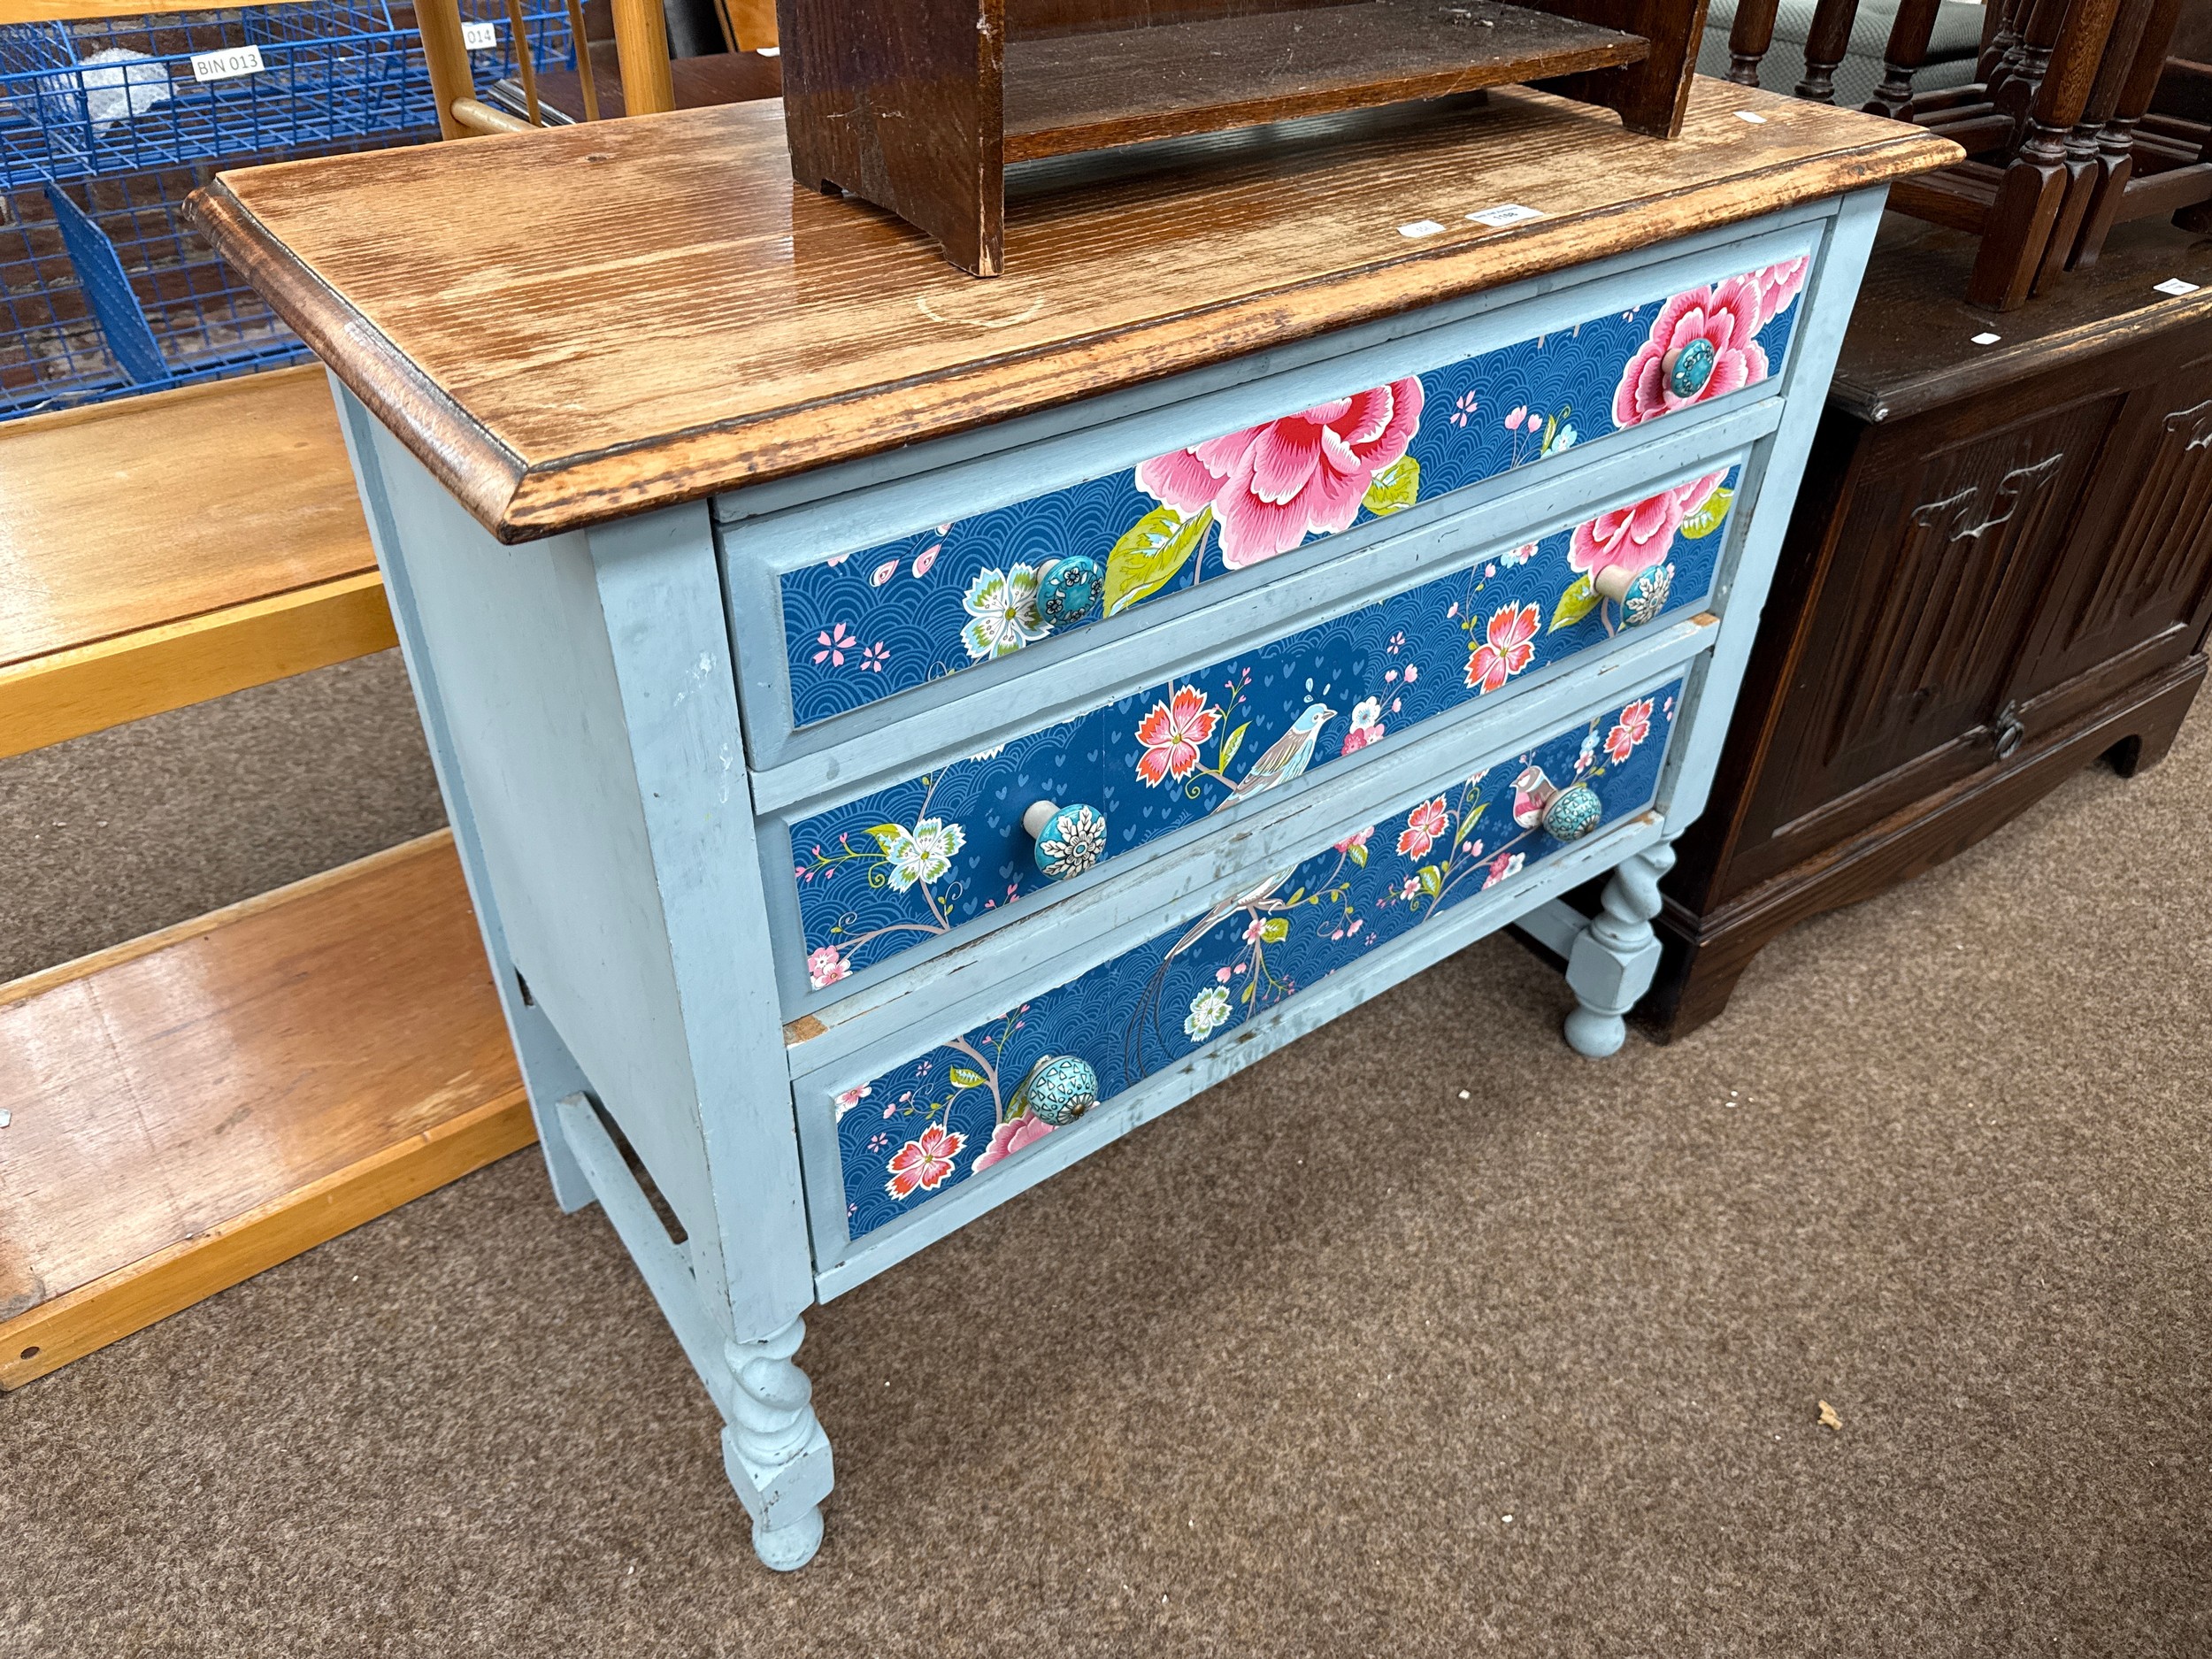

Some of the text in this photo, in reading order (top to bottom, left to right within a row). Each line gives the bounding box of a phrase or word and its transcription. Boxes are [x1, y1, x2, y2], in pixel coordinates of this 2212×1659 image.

[467, 29, 491, 43] 014
[197, 54, 257, 75] BIN 013
